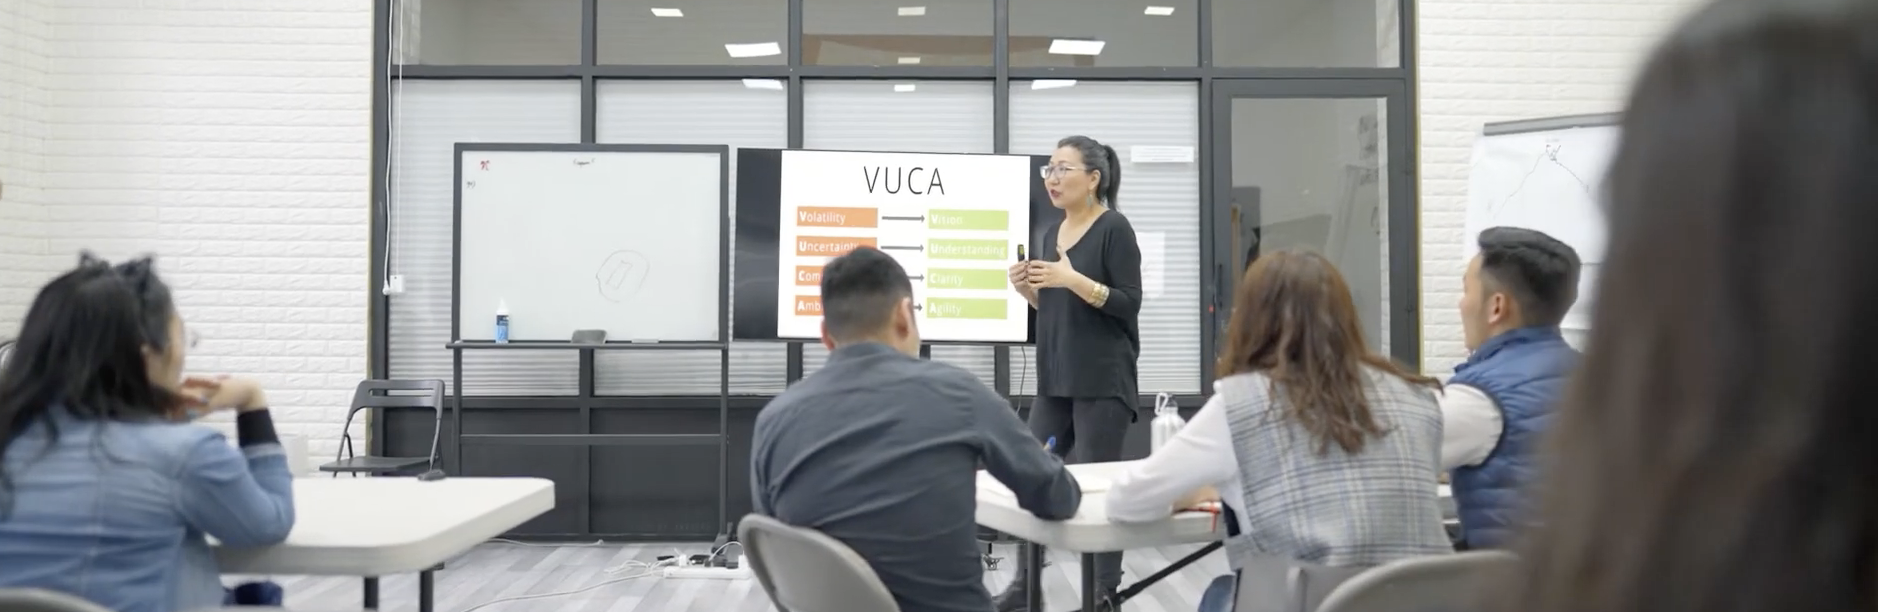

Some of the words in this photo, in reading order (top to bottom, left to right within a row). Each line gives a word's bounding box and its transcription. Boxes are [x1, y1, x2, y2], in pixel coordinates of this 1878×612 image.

[863, 166, 945, 195] VUCA
[799, 211, 846, 226] Volatility
[930, 214, 963, 225] Vision
[930, 243, 1005, 258] Understanding
[929, 273, 963, 287] Clarity
[928, 302, 962, 317] Agility
